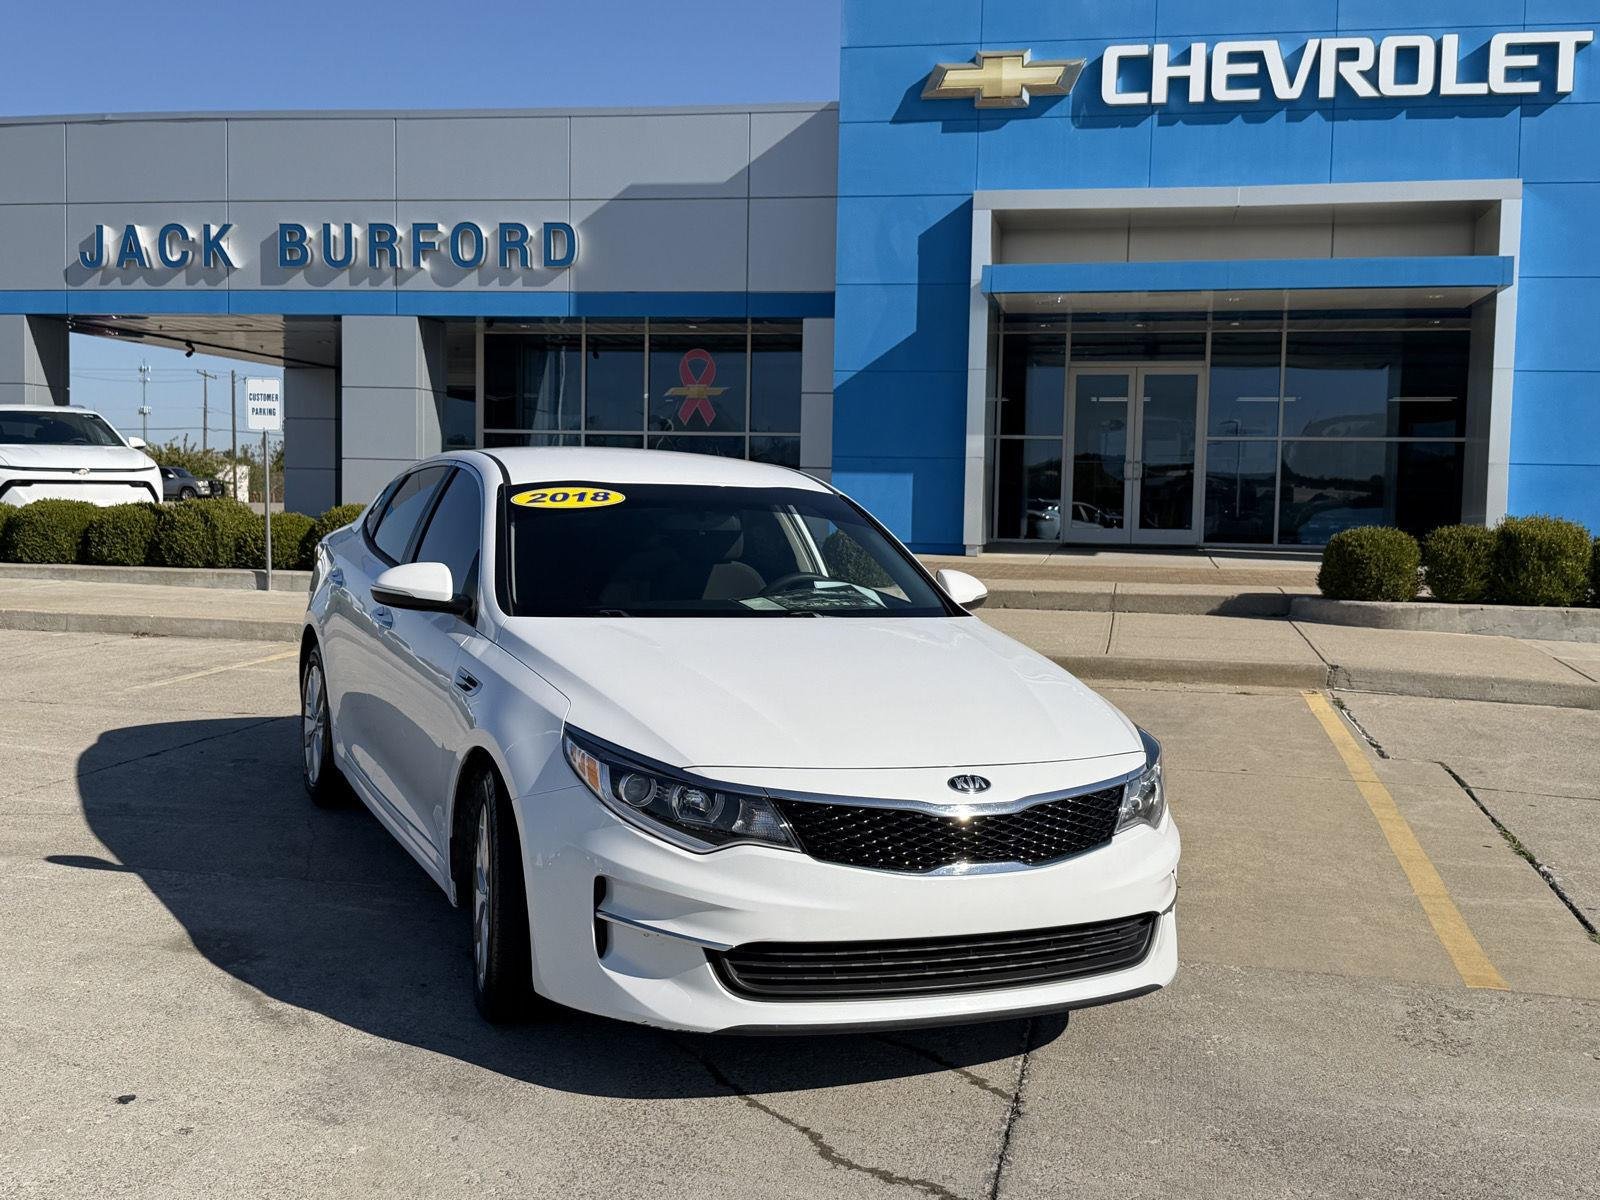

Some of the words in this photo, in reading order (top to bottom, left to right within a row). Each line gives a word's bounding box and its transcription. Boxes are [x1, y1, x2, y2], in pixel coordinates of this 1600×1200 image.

[1101, 30, 1593, 105] CHEVROLET
[79, 223, 240, 270] JACK
[278, 220, 579, 269] BURFORD
[248, 392, 278, 402] CUSTOMER
[251, 407, 276, 416] PARKING
[526, 491, 611, 504] 2018
[953, 776, 987, 790] KIA
